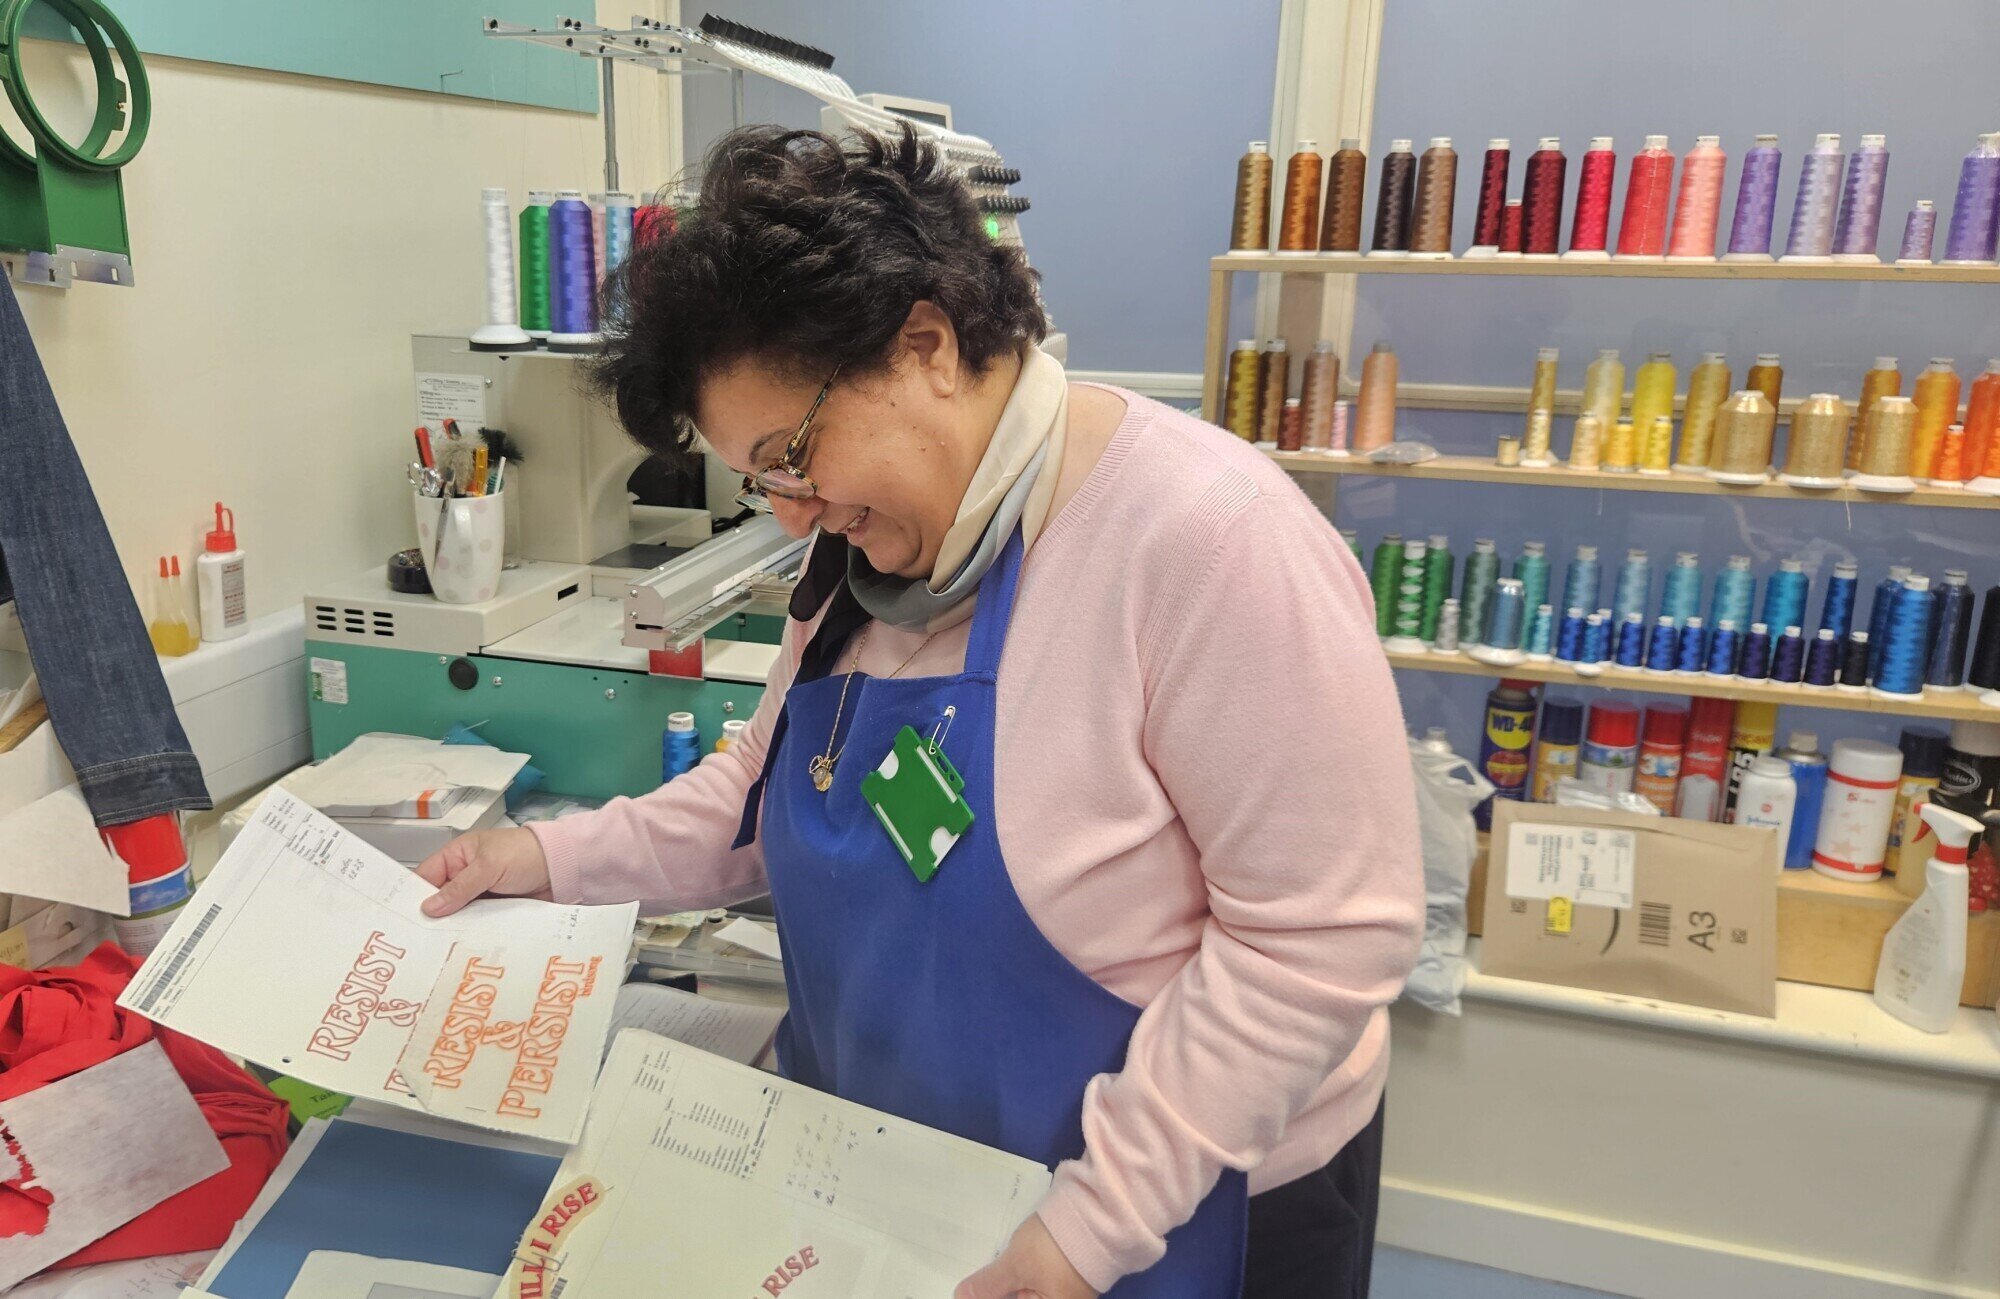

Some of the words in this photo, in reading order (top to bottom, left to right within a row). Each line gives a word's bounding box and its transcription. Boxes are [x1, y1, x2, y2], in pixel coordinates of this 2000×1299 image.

[1492, 713, 1533, 732] WD-4
[1687, 911, 1716, 953] A3
[307, 930, 406, 1062] RESIST
[374, 998, 422, 1027] &
[423, 956, 505, 1089] RESIST
[480, 1020, 526, 1049] &
[497, 955, 585, 1119] PERSIST
[540, 1182, 599, 1238] RISE
[530, 1238, 552, 1252] I
[762, 1245, 820, 1299] RISE
